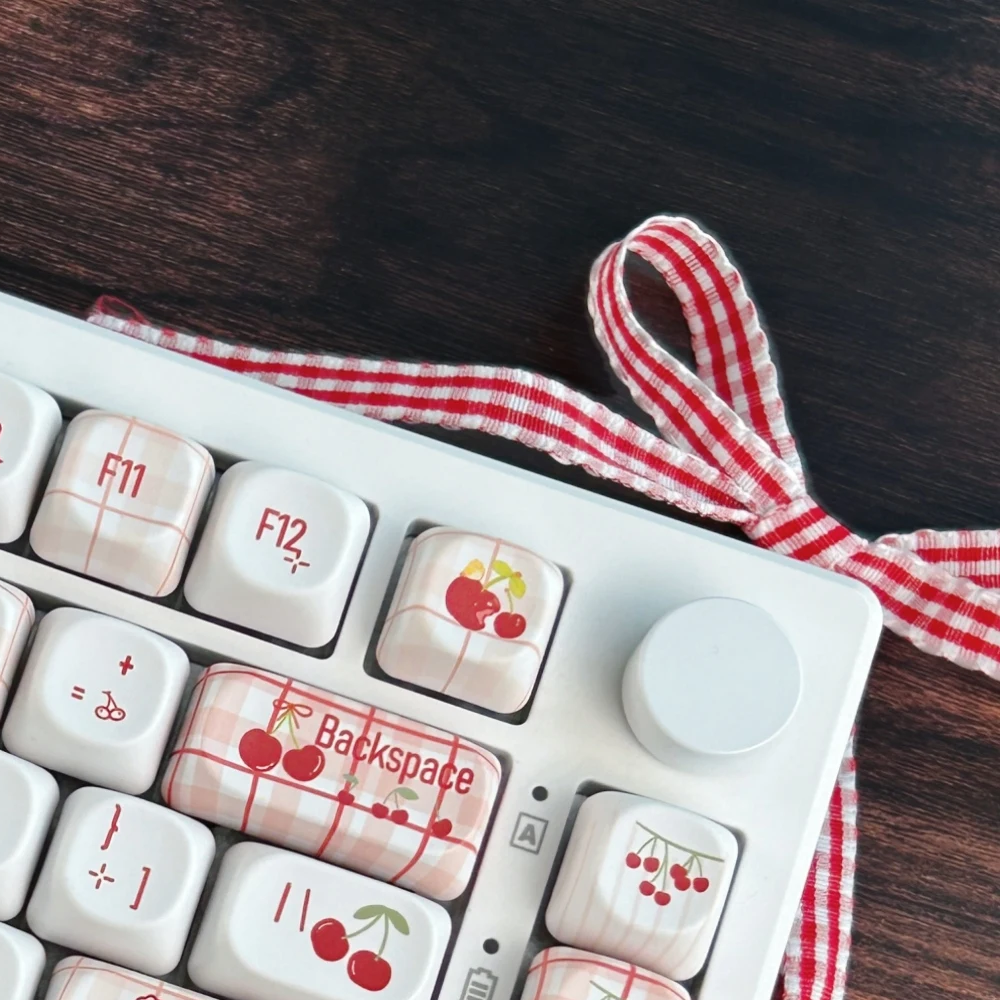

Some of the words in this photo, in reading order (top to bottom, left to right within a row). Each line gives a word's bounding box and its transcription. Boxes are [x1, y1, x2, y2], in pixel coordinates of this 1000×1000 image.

[98, 453, 146, 498] F11
[255, 508, 307, 557] F12
[119, 656, 134, 675] +
[71, 686, 86, 700] =
[314, 713, 475, 795] Backspace
